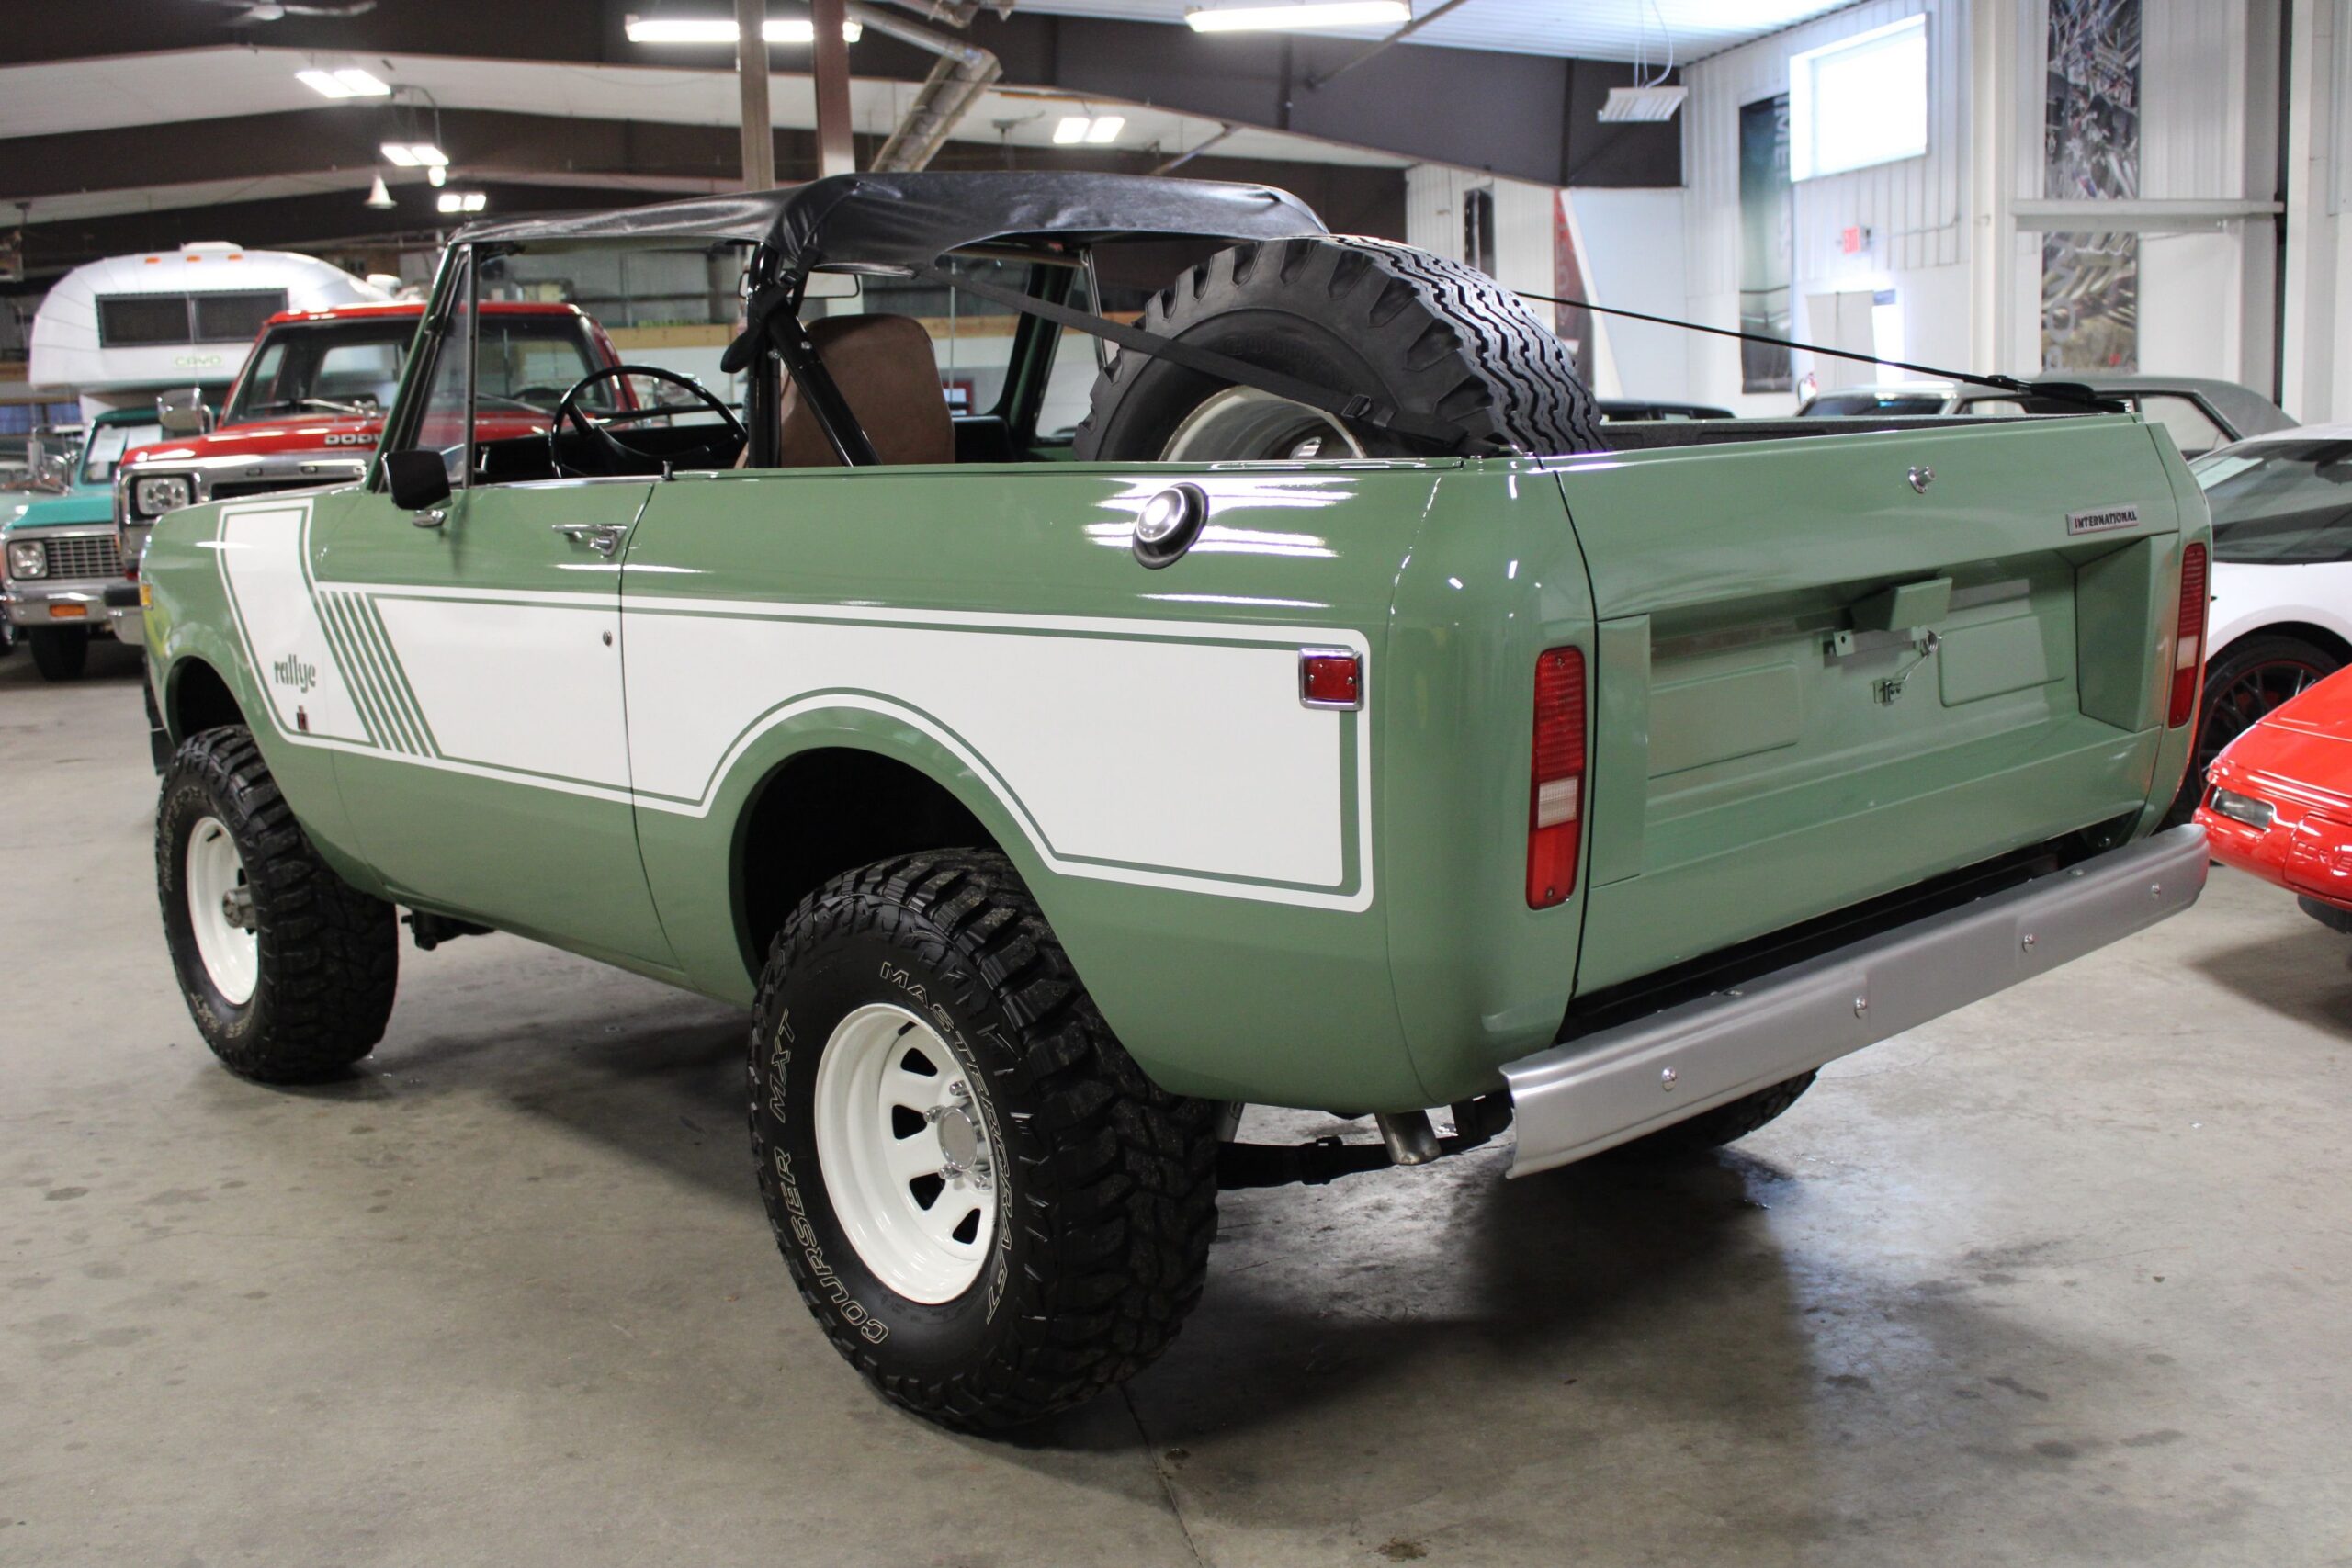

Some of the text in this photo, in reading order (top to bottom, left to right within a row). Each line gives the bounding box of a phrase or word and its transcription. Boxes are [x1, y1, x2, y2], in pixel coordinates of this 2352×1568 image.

[2075, 511, 2137, 529] INTERNATIONAL
[274, 654, 316, 694] rallye
[769, 1007, 796, 1123] MXT
[880, 961, 1013, 1325] MASTERCRAFT
[774, 1147, 889, 1344] COURSER
